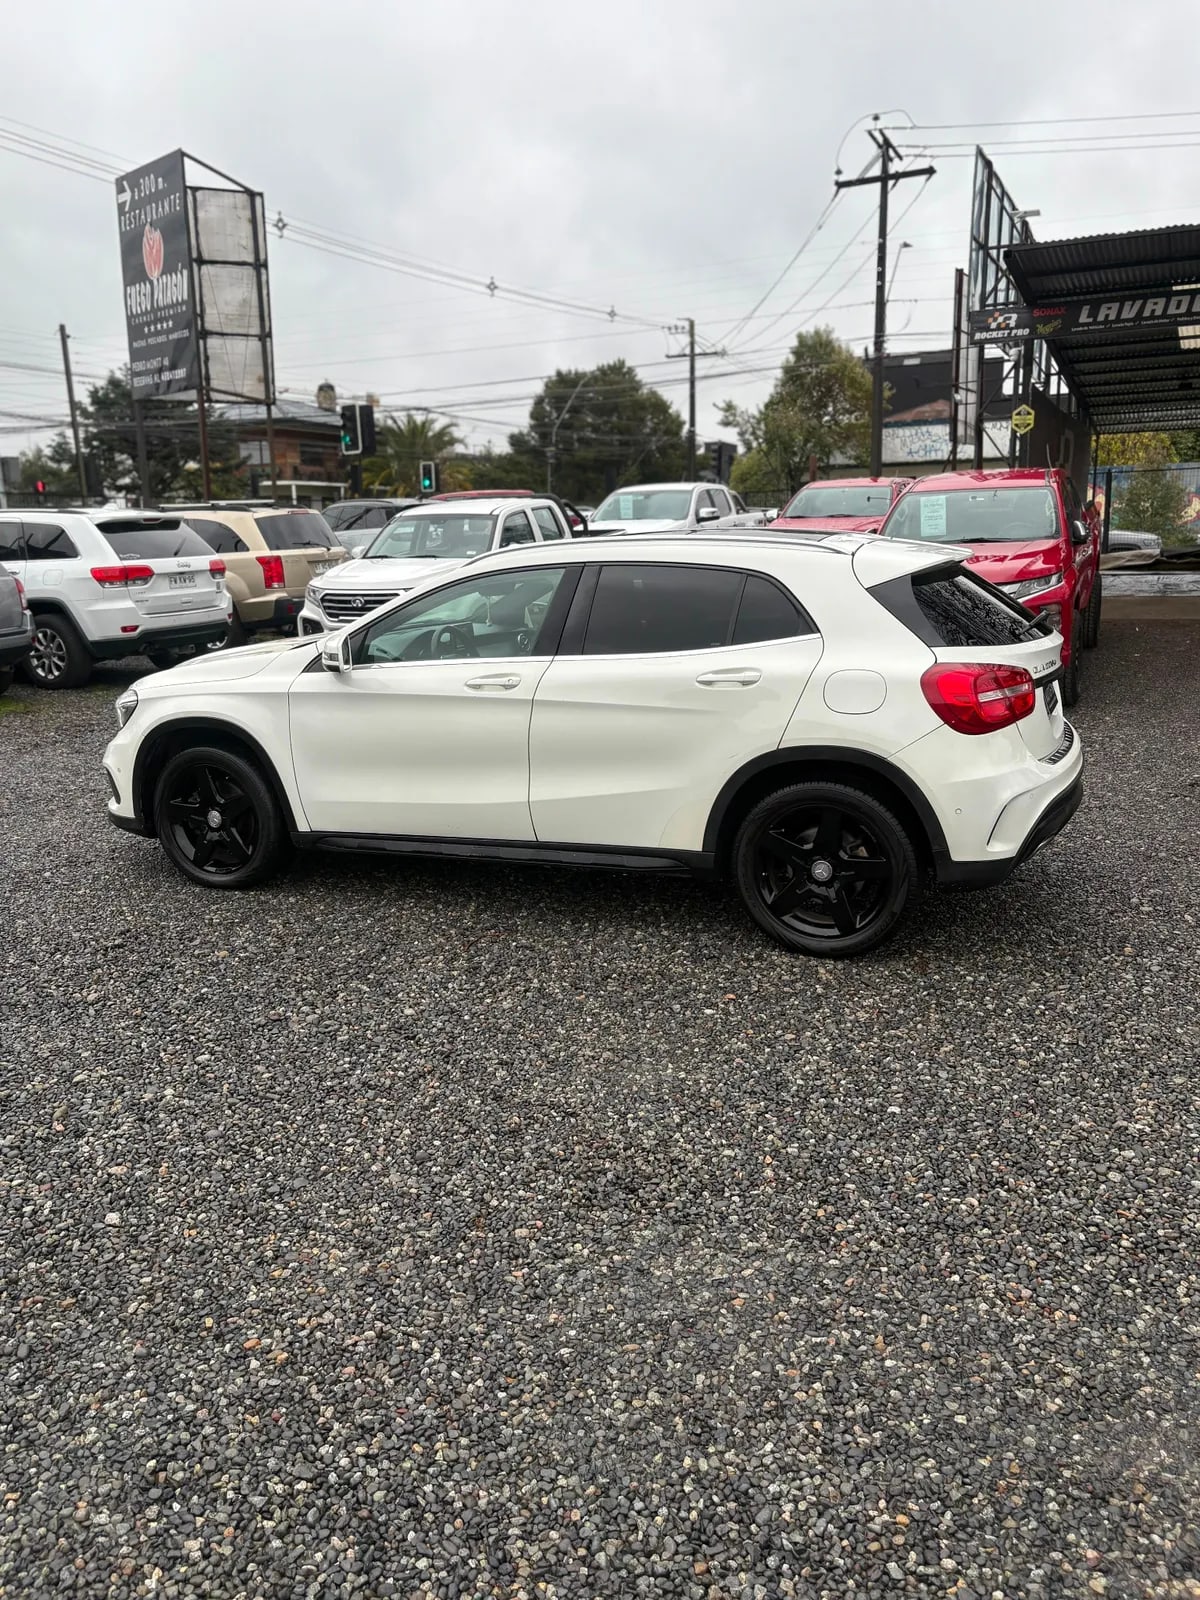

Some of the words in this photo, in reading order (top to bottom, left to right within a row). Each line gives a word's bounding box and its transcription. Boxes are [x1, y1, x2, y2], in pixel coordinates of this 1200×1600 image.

[140, 173, 156, 197] 300
[121, 192, 180, 232] RESTAURANTE
[126, 280, 152, 316] FUEGO
[974, 329, 1010, 340] ROCKET
[1011, 328, 1030, 337] PRO
